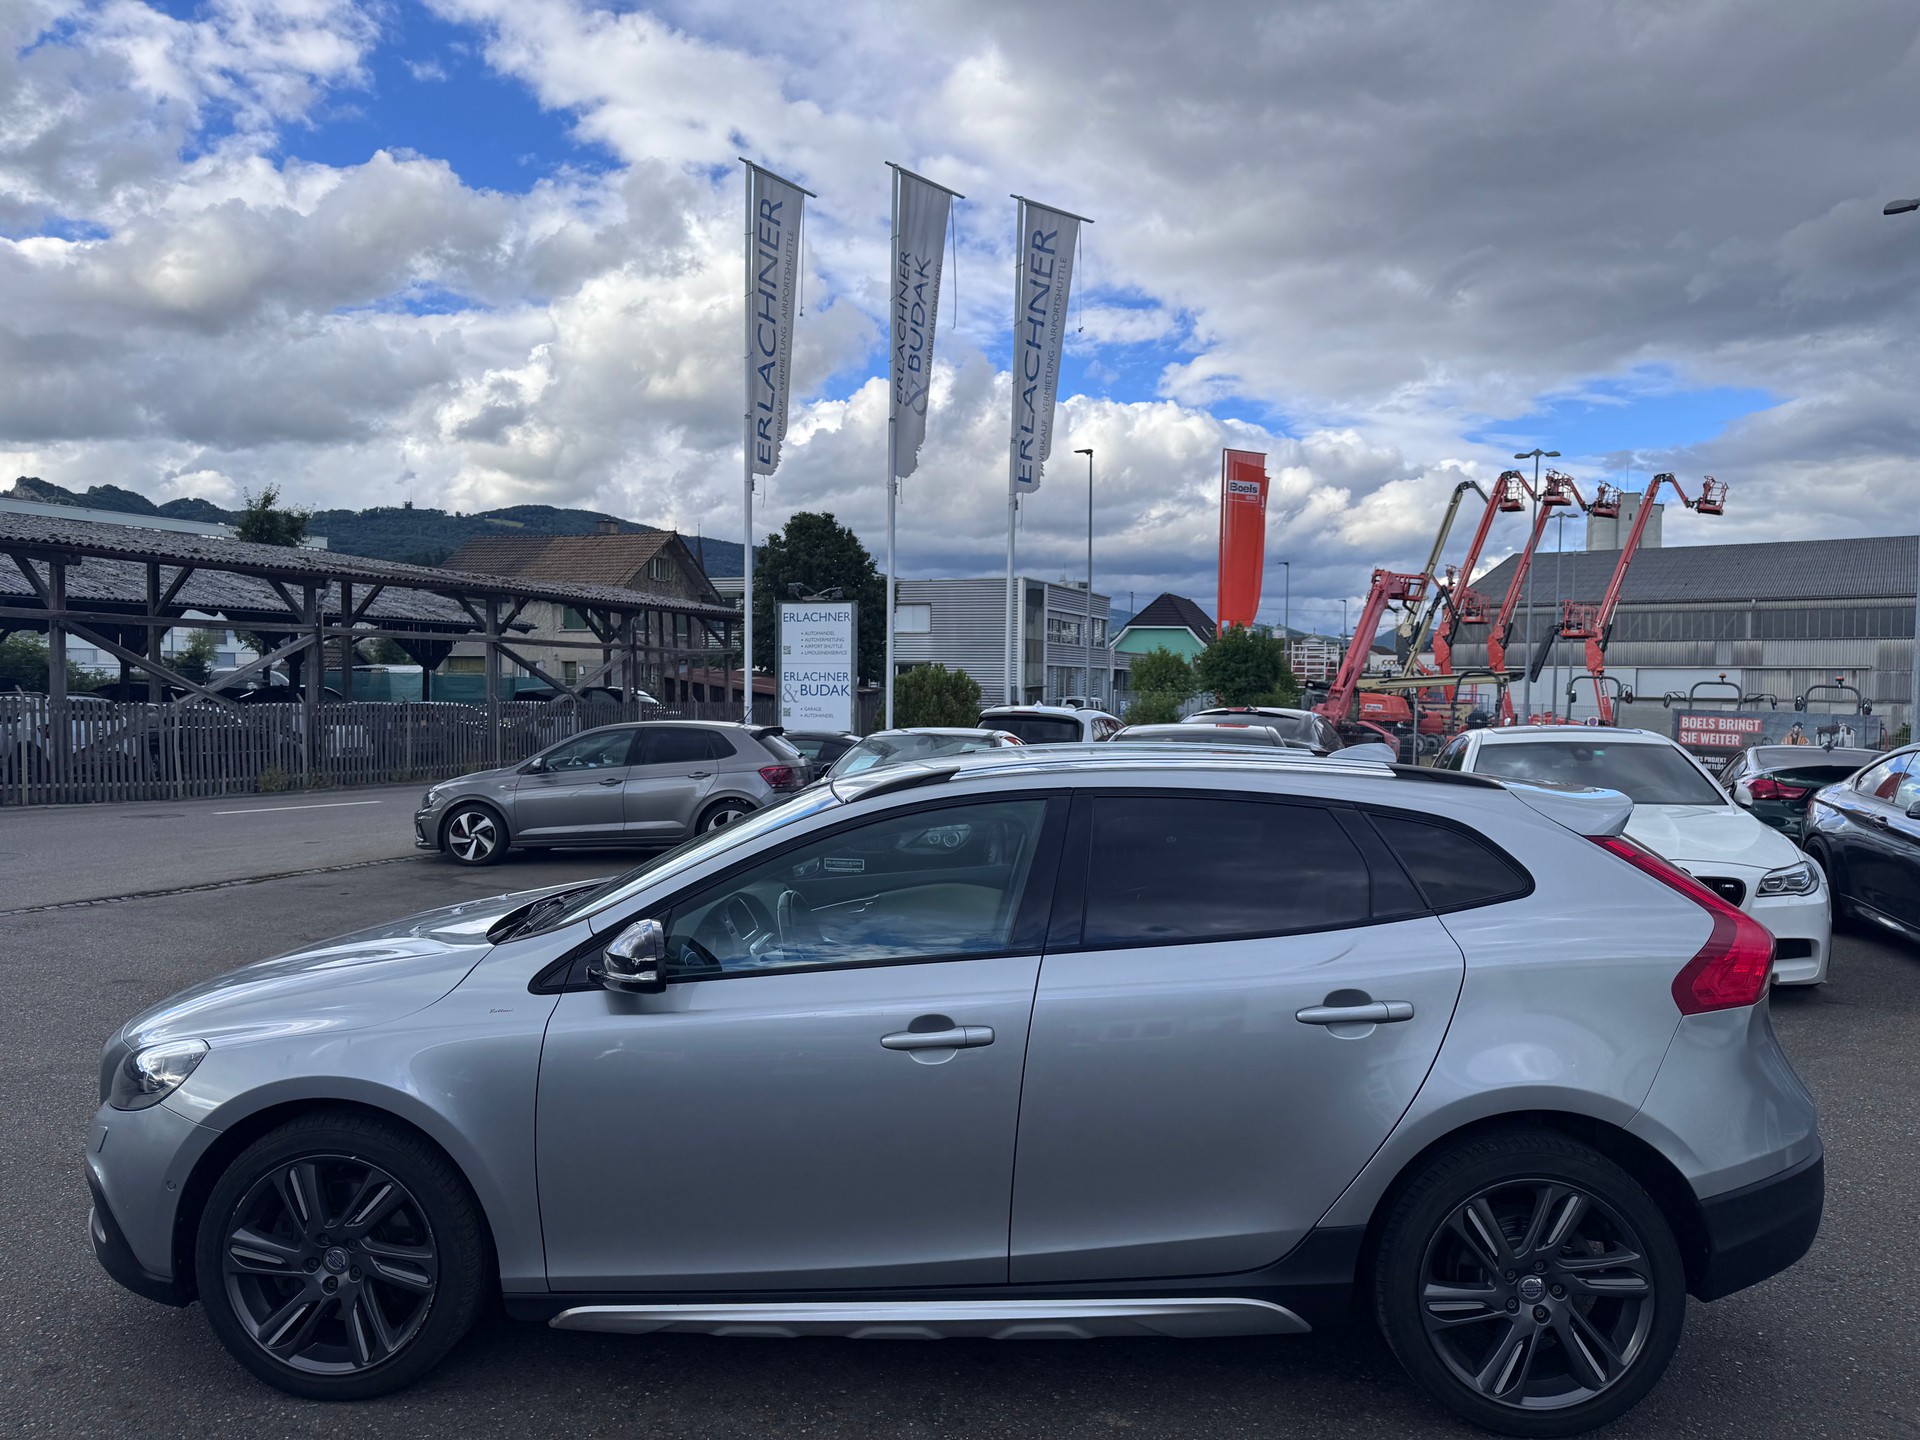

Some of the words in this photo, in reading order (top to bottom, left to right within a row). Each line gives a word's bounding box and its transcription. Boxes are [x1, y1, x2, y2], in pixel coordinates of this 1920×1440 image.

[781, 230, 795, 320] AIRPORTSHUTTLE
[1049, 256, 1068, 344] AIRPORTSHUTTLE
[756, 197, 783, 465] ERLACHNER
[896, 251, 910, 405] ERLACHNER
[907, 256, 932, 374] BUDAK
[779, 327, 788, 391] VERMIETUNG
[1018, 229, 1058, 484] ERLACHNER
[1042, 349, 1056, 413] VERMIETUNG
[776, 398, 785, 442] VERKAUF
[1038, 418, 1049, 462] VERKAUF
[1229, 482, 1258, 494] Boels
[783, 612, 851, 623] ERLACHNER
[782, 683, 799, 703] &
[800, 684, 851, 697] BUDAK
[783, 671, 850, 682] ERLACHNER
[1681, 717, 1716, 730] BOELS
[1718, 718, 1761, 732] BRINGT
[1681, 731, 1697, 744] SIE
[1700, 733, 1740, 746] WEITER
